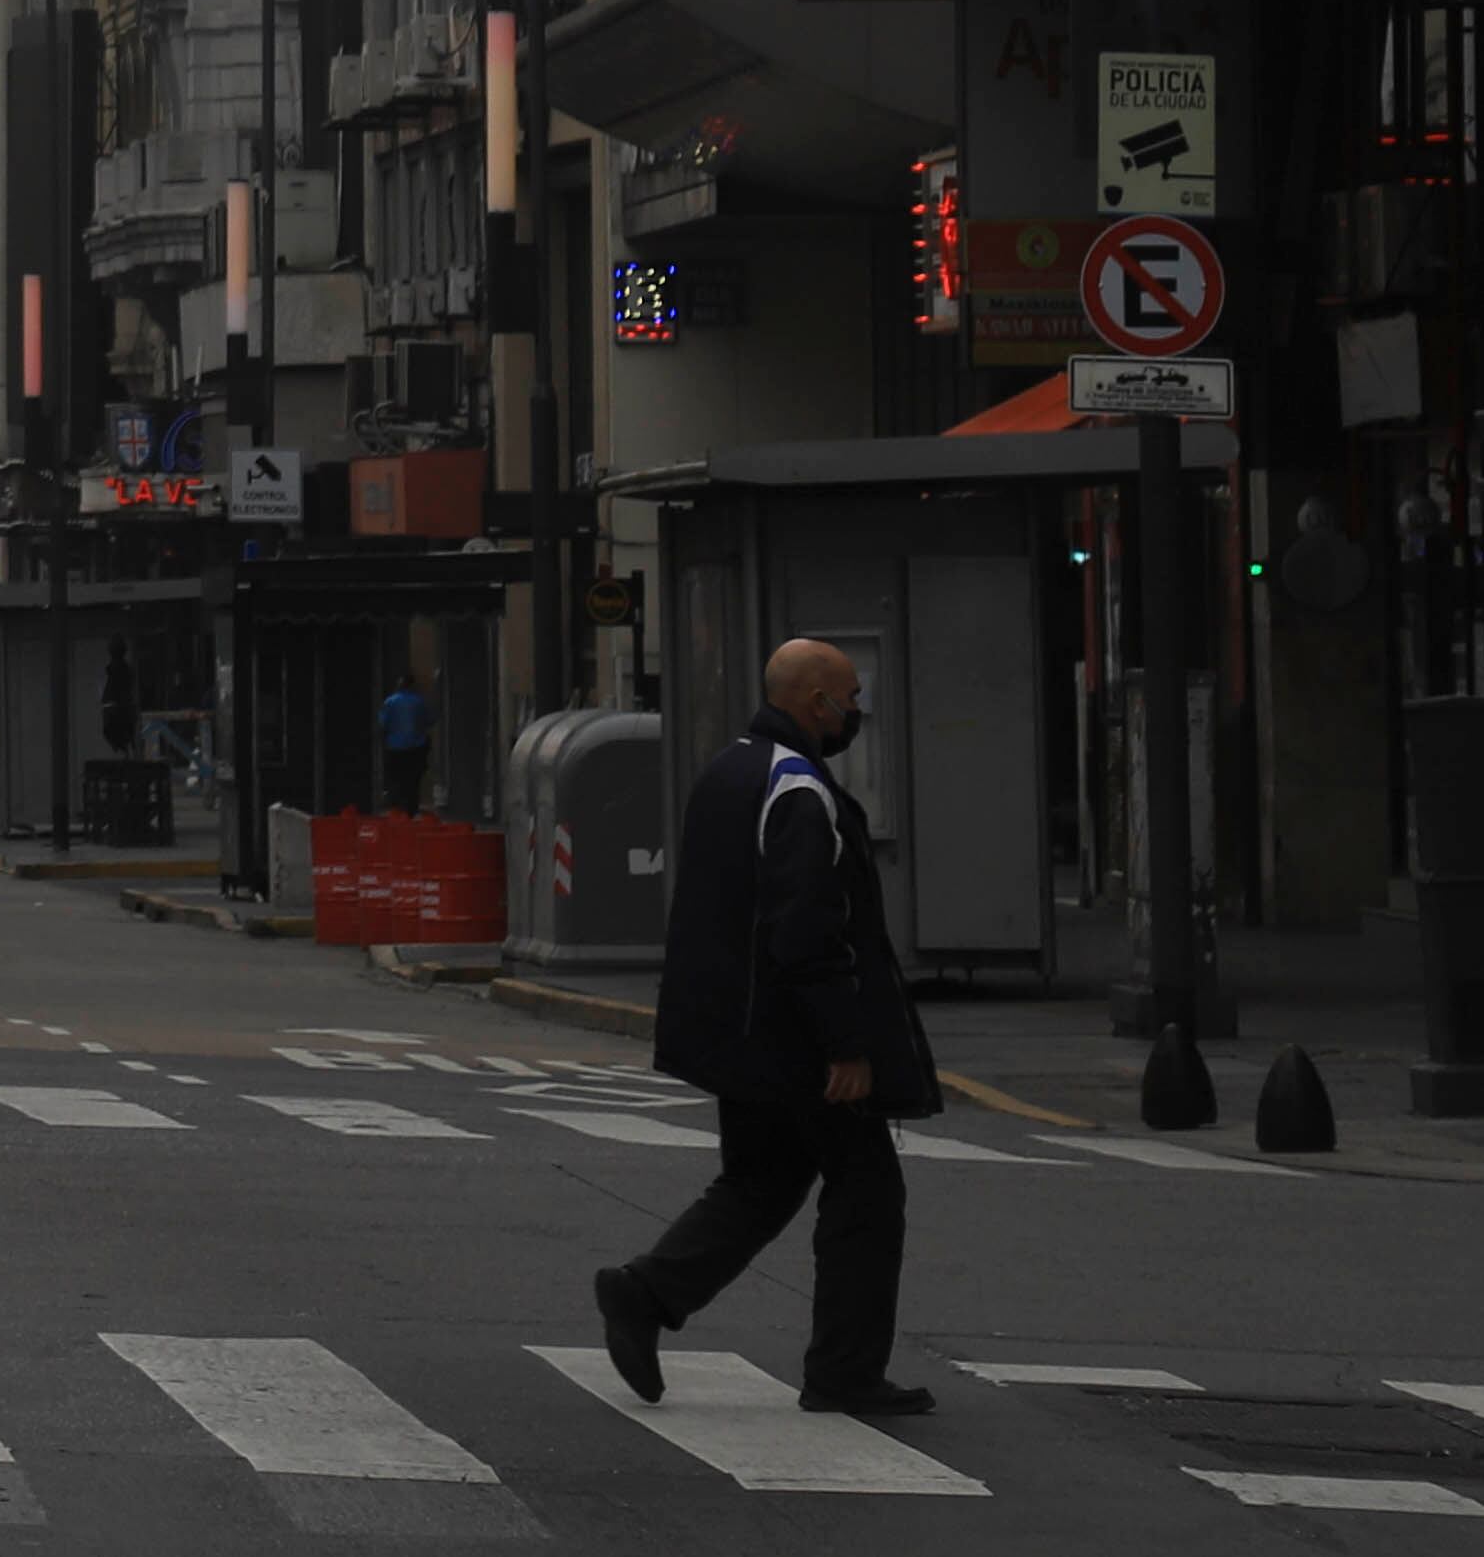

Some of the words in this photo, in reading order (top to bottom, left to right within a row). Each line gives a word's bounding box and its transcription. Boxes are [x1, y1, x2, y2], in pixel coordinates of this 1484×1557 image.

[1109, 93, 1129, 109] DE
[1133, 93, 1152, 109] LA
[1154, 94, 1208, 112] CIUDAD
